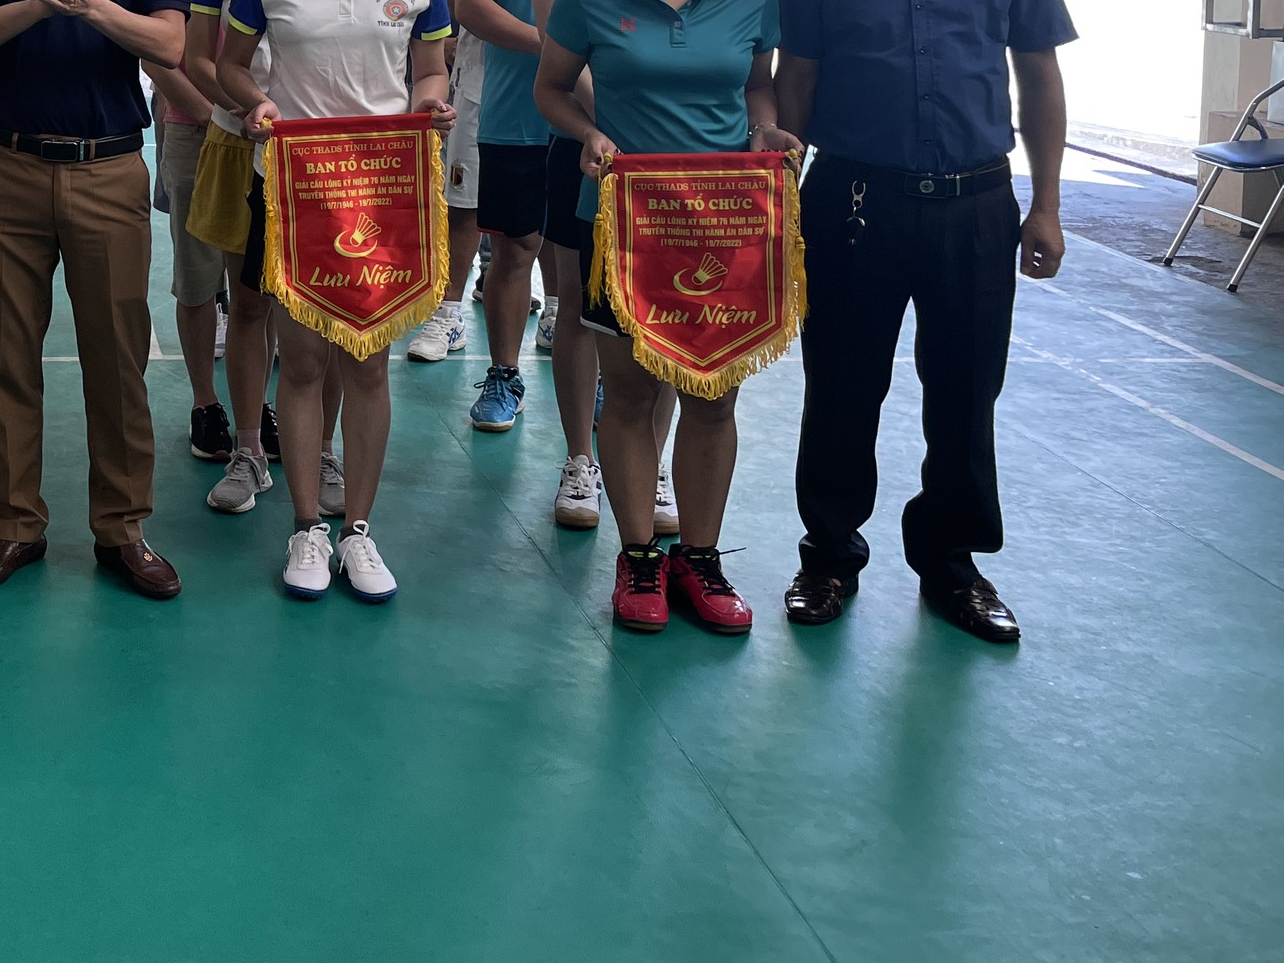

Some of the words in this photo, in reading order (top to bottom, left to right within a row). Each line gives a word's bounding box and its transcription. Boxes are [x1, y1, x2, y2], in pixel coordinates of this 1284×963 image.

[312, 146, 342, 154] THADS
[370, 143, 385, 151] LAI
[306, 163, 335, 174] BAN
[339, 154, 357, 172] TỔ
[361, 155, 401, 169] CHỨC
[656, 183, 688, 191] THADS
[648, 199, 681, 210] BAN
[685, 193, 704, 210] TỔ
[709, 195, 752, 210] CHỨC
[309, 267, 350, 287] Lưu
[356, 264, 412, 289] Niệm
[646, 304, 688, 324] Lưu
[696, 304, 756, 329] Niệm
